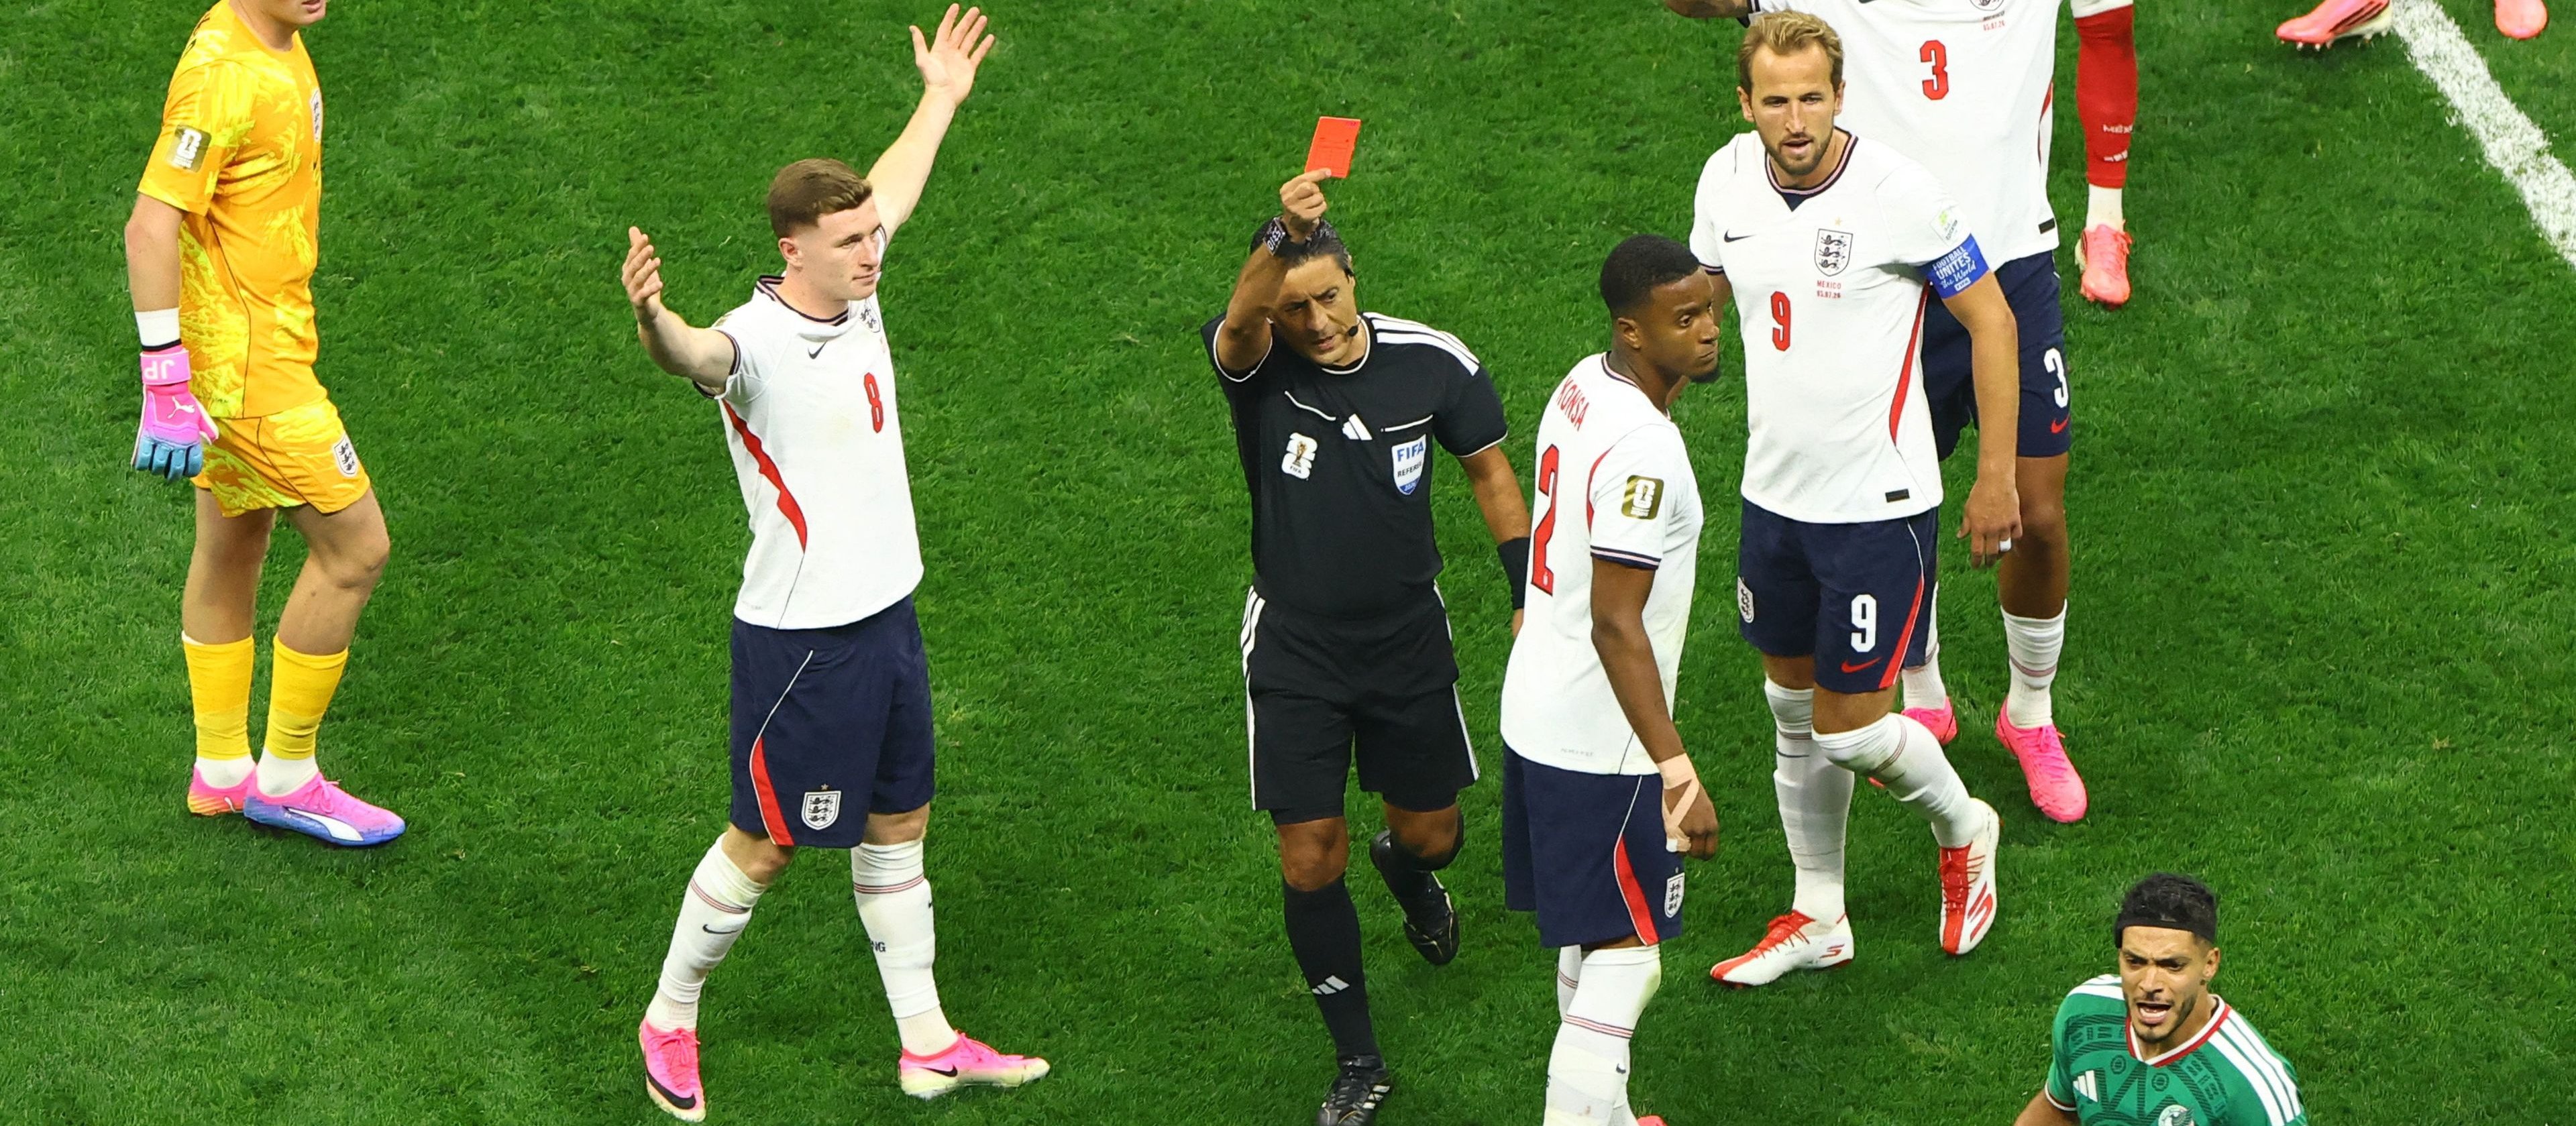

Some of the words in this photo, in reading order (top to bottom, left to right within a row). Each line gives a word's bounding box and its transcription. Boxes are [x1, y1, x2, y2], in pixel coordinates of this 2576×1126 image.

[1920, 40, 1949, 100] 3
[1817, 280, 1841, 289] MEXICO
[1933, 246, 1966, 271] FOOTBALL
[1936, 252, 1971, 280] UNITES
[1953, 260, 1976, 282] World
[1770, 291, 1790, 351] 9
[144, 359, 175, 380] JP
[2043, 347, 2069, 408] 3
[864, 372, 883, 433] 8
[1556, 376, 1589, 431] KONSA
[1397, 441, 1424, 462] FIFA
[1531, 444, 1559, 596] 2
[1851, 594, 1877, 653] 9
